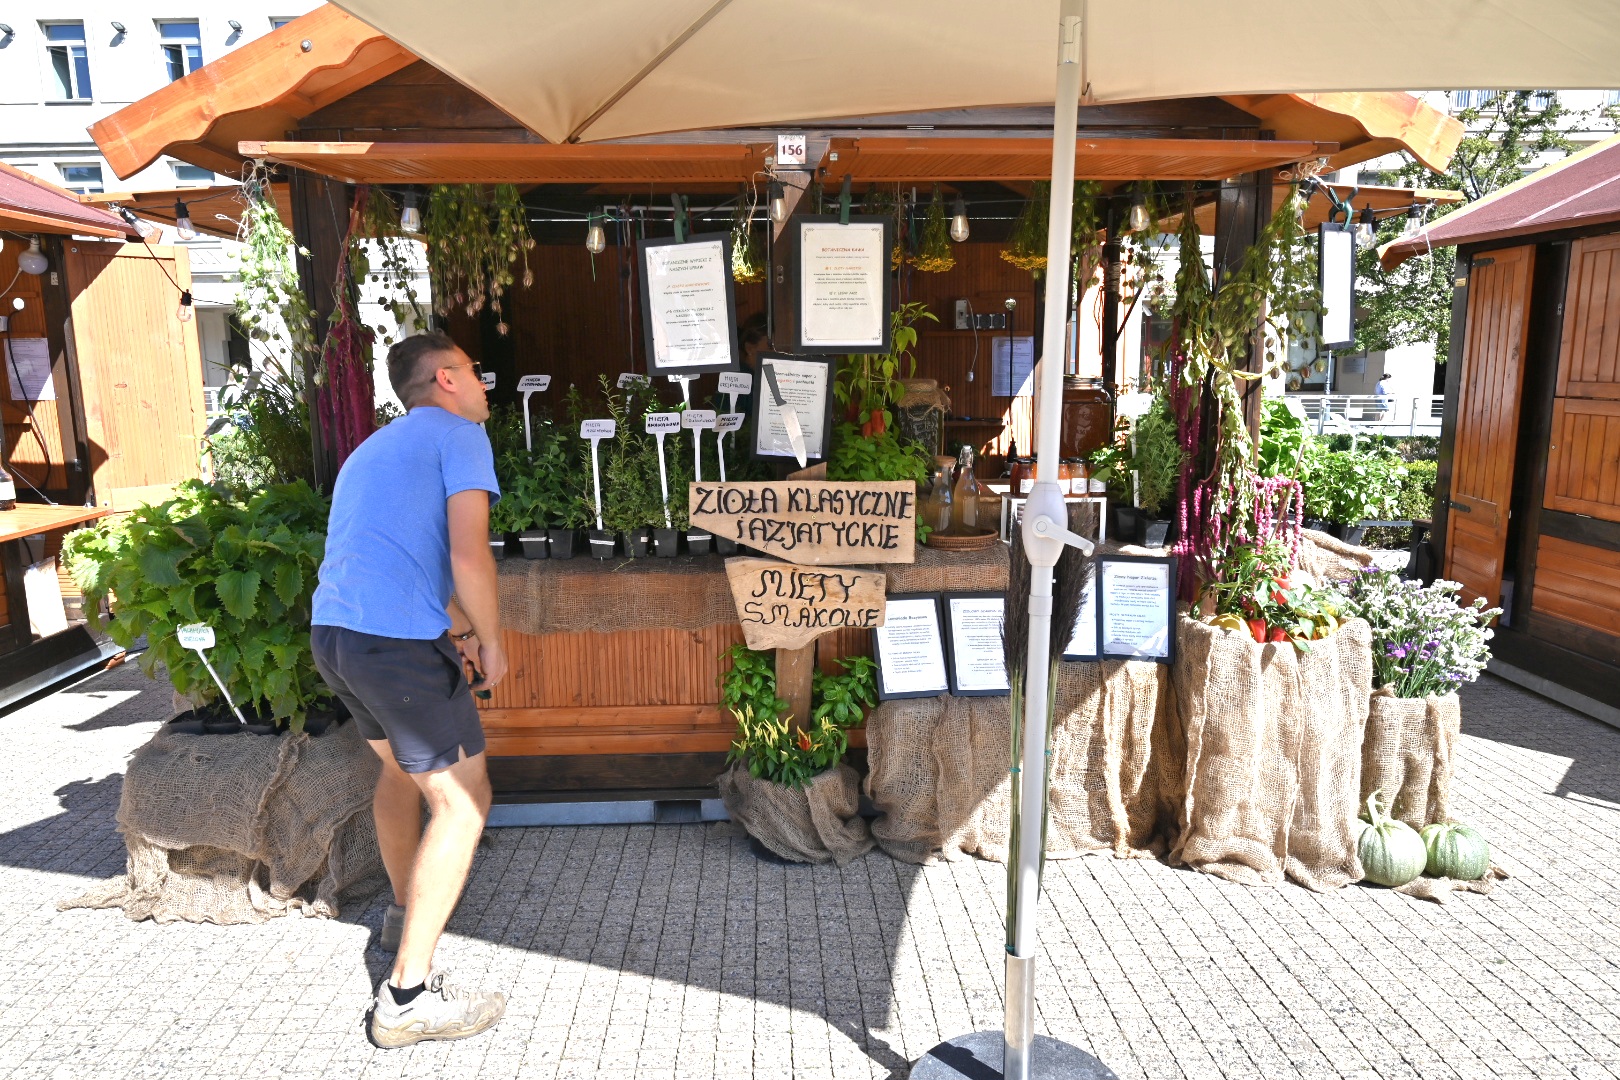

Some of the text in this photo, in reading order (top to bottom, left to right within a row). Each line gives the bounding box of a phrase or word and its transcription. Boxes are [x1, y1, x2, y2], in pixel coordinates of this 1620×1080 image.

[782, 144, 803, 156] 156
[692, 486, 914, 520] ZIOŁA KLASYCZNE
[748, 517, 899, 550] AZJATYCKIE
[751, 568, 862, 607] MIĘTY
[741, 601, 881, 628] SMAKOWE
